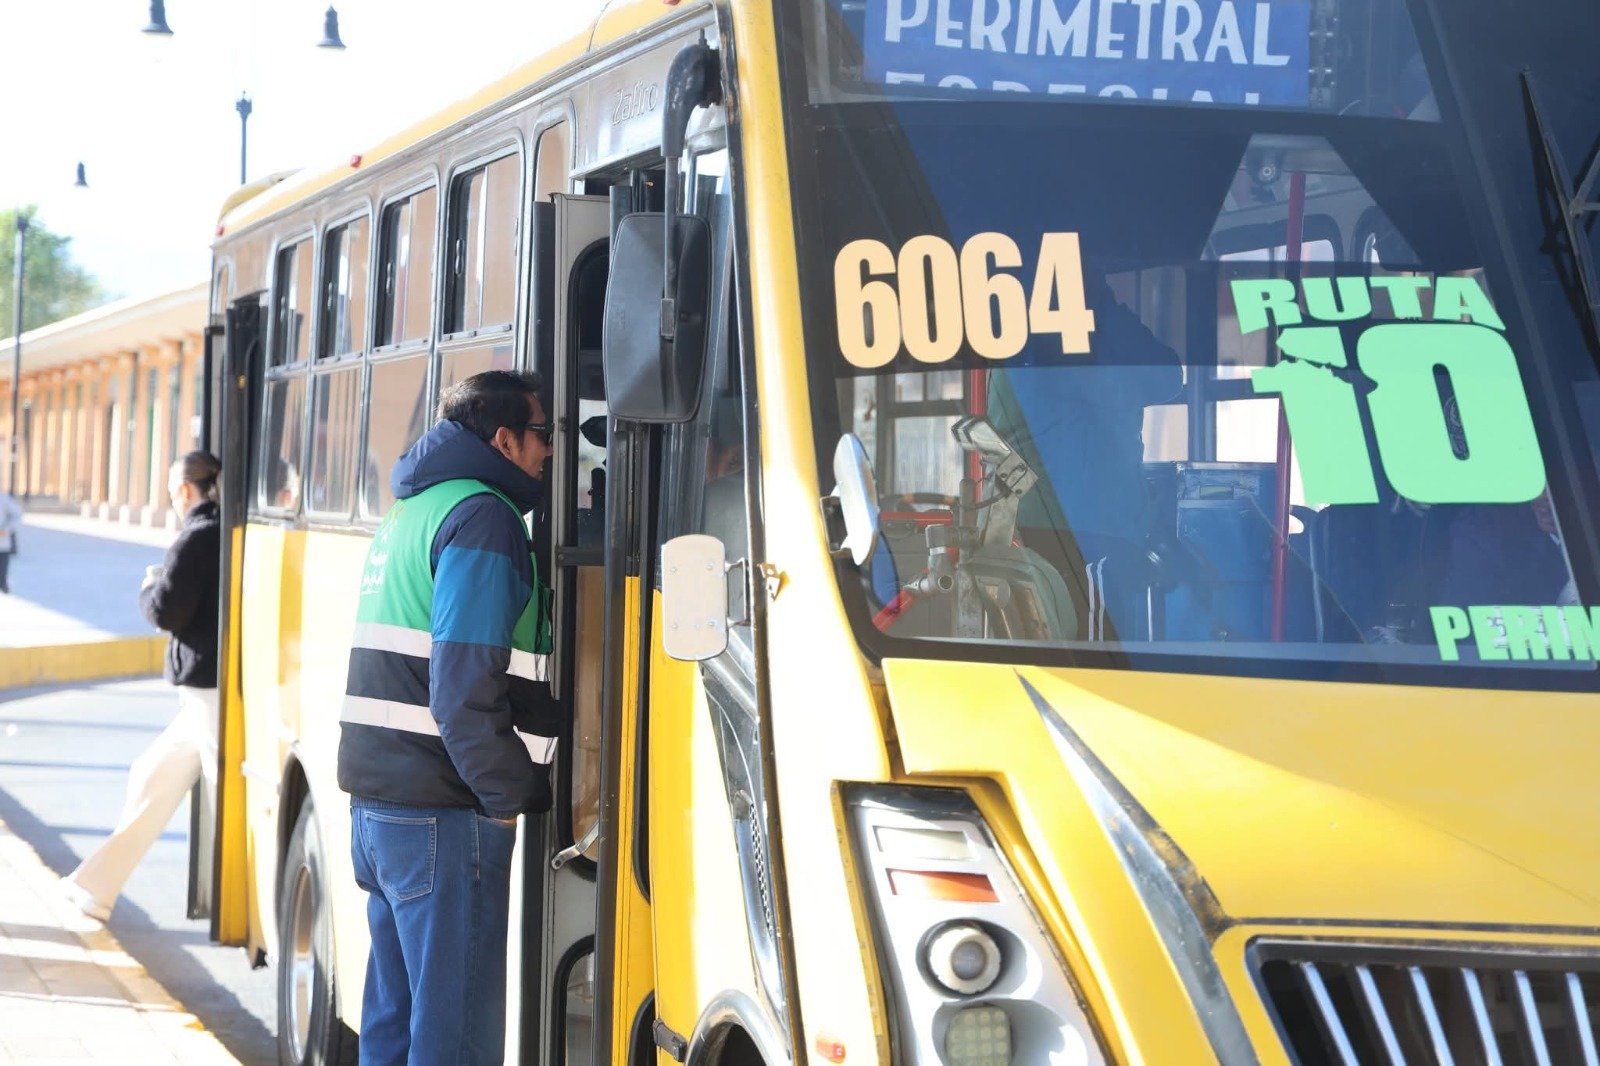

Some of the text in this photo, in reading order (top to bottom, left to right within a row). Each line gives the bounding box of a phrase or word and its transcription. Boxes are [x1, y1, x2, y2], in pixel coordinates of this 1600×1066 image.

[884, 0, 1291, 66] PERIMETRAL
[834, 231, 1095, 369] 6064
[1230, 276, 1506, 335] RUTA
[1251, 323, 1546, 505] 10
